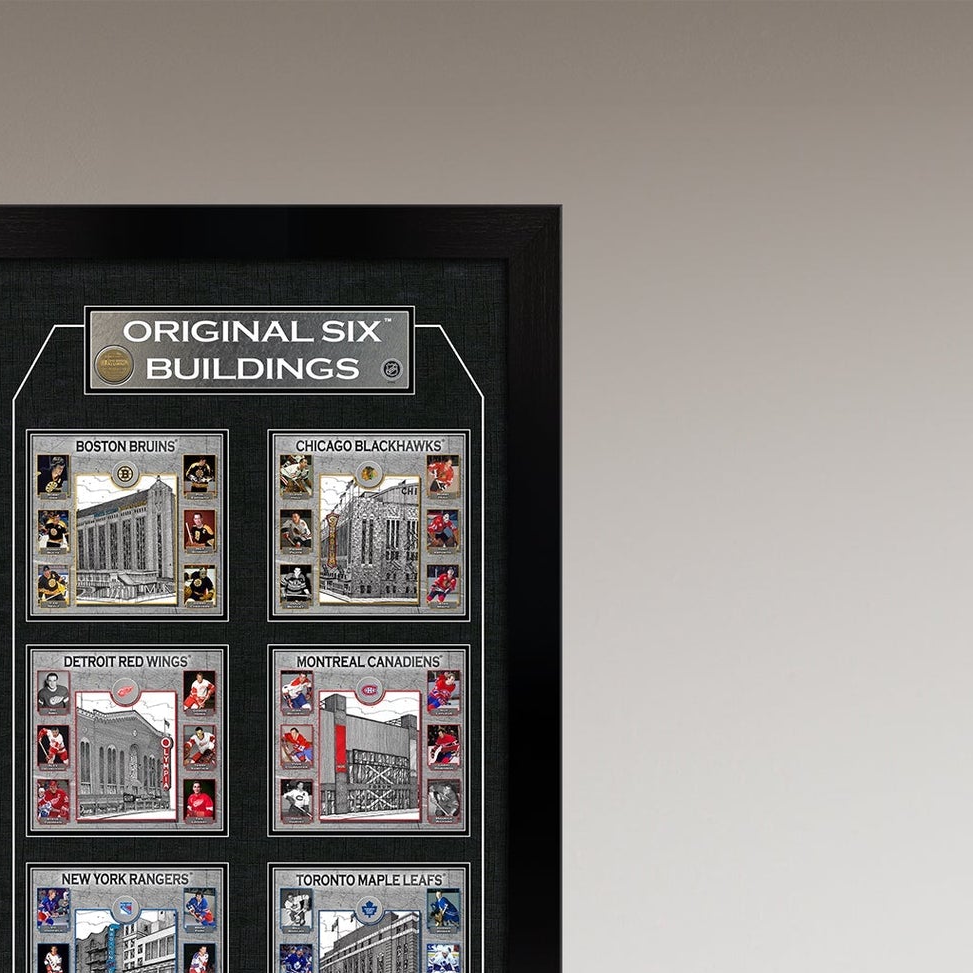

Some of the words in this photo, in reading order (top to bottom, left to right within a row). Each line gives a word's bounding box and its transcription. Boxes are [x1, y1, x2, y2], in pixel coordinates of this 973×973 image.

[123, 320, 315, 343] ORIGINAL
[321, 320, 382, 343] SIX
[146, 357, 360, 380] BUILDINGS
[76, 440, 127, 453] BOSTON
[129, 440, 176, 453] BRUINS
[295, 439, 353, 452] CHICAGO
[355, 439, 443, 452] BLACKHAWKS
[64, 655, 117, 668] DETROIT
[118, 655, 144, 668] RED
[146, 655, 188, 668] WINGS
[297, 655, 366, 668] MONTREAL
[367, 655, 441, 668] CANADIENS
[62, 873, 92, 885] NEW
[93, 873, 127, 885] YORK
[129, 873, 189, 885] RANGERS
[296, 874, 356, 887] TORONTO
[358, 874, 401, 887] MAPLE
[403, 874, 443, 887] LEAFS
